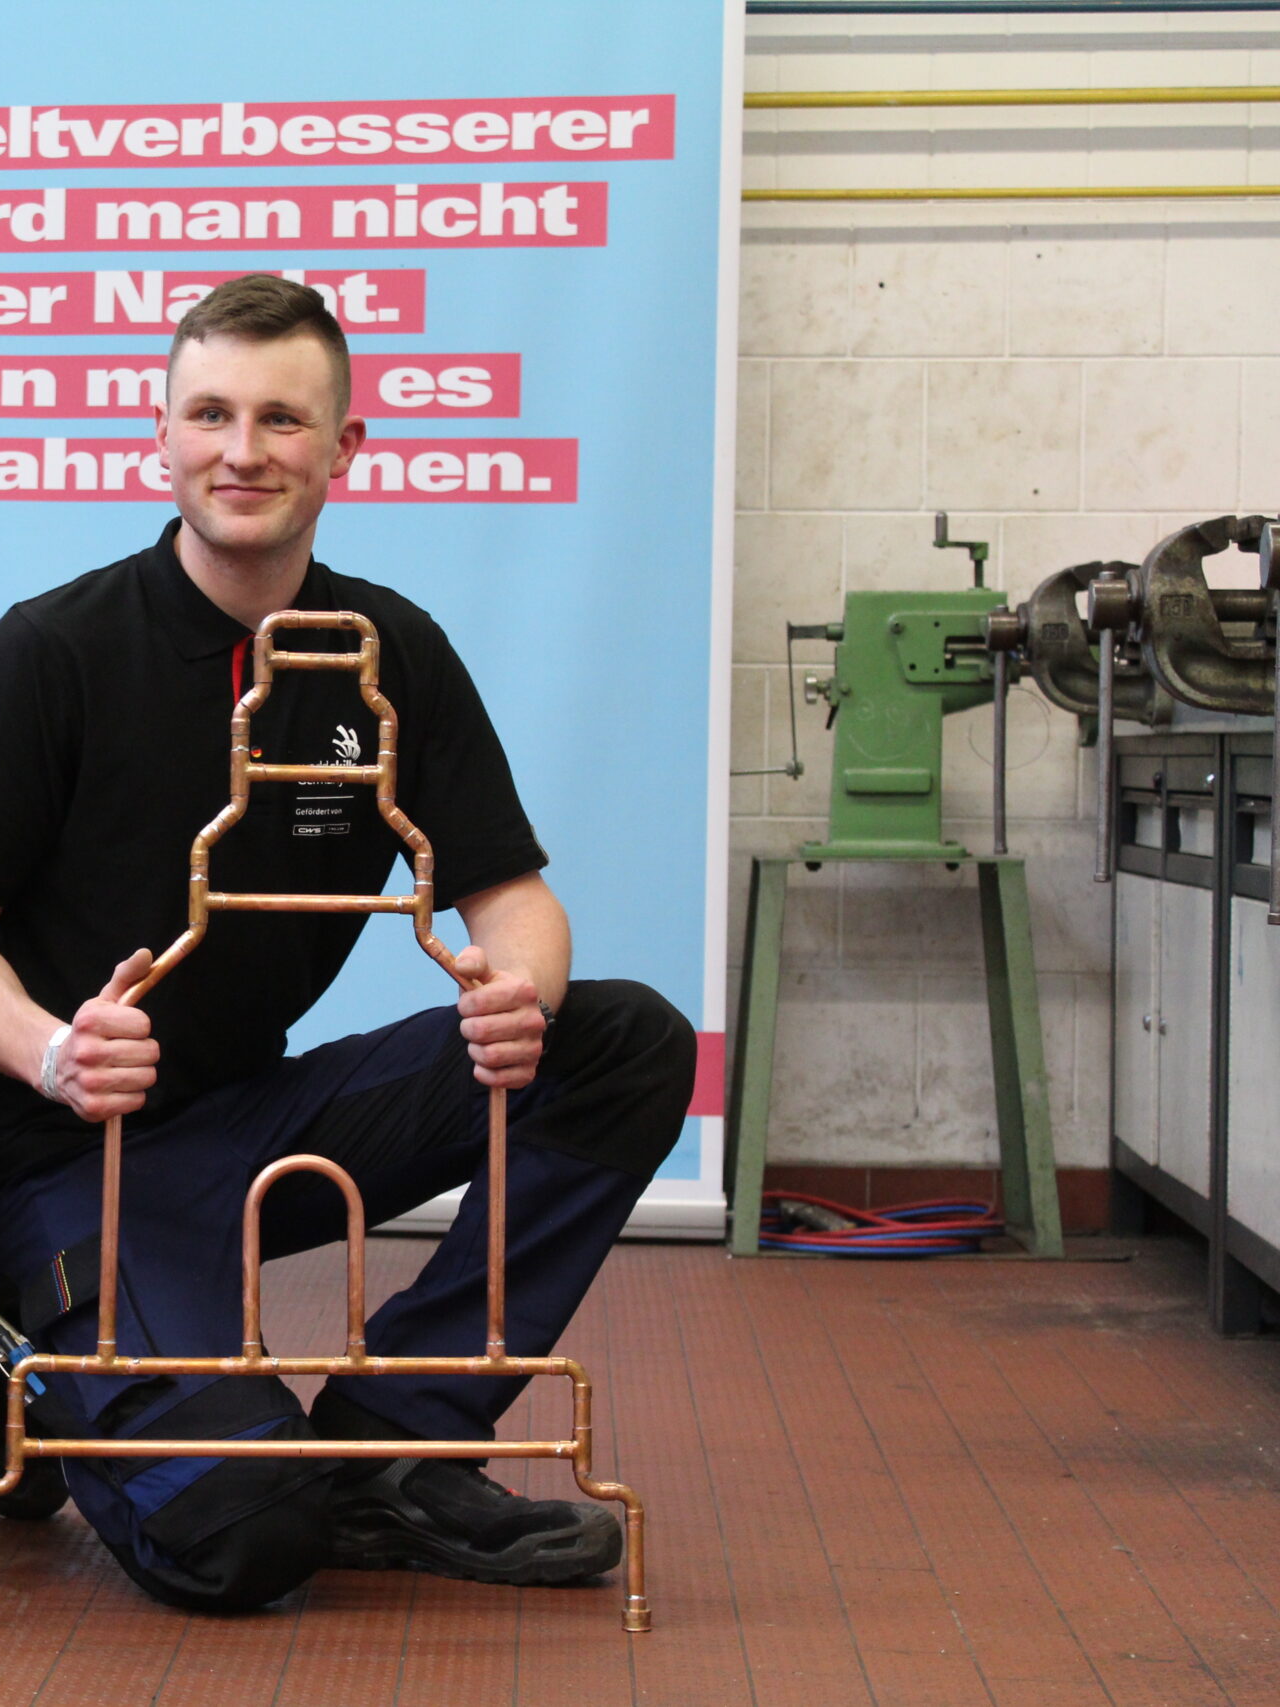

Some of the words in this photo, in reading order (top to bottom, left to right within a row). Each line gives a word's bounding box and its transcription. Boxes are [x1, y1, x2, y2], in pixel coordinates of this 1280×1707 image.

[96, 200, 300, 242] man
[332, 182, 578, 238] nicht
[94, 269, 400, 324] Nat.
[378, 366, 493, 408] es
[295, 807, 330, 816] Gefördert
